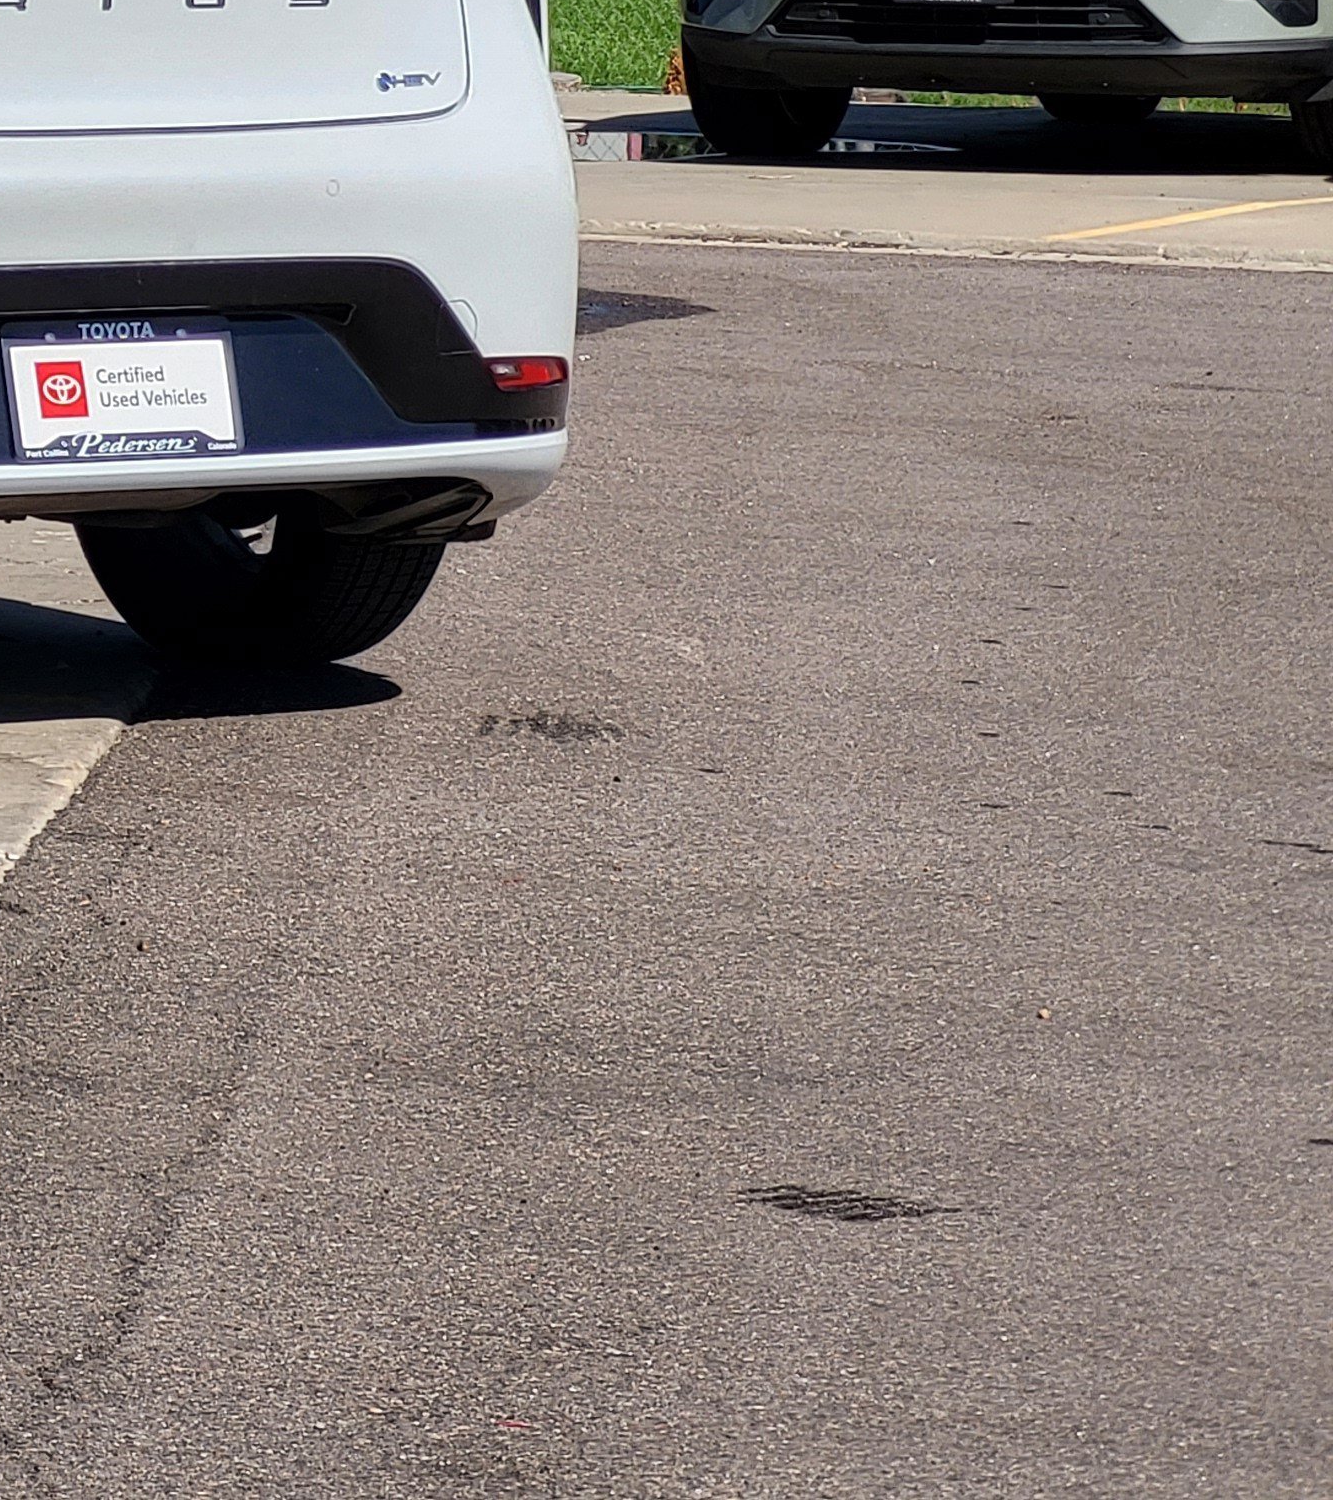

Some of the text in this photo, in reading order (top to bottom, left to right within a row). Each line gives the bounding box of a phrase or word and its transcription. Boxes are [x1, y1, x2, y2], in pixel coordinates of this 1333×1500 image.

[78, 321, 155, 339] TOYOTA
[95, 365, 165, 385] Certified
[99, 388, 208, 408] Used Vehicles
[71, 430, 199, 458] Pedersen
